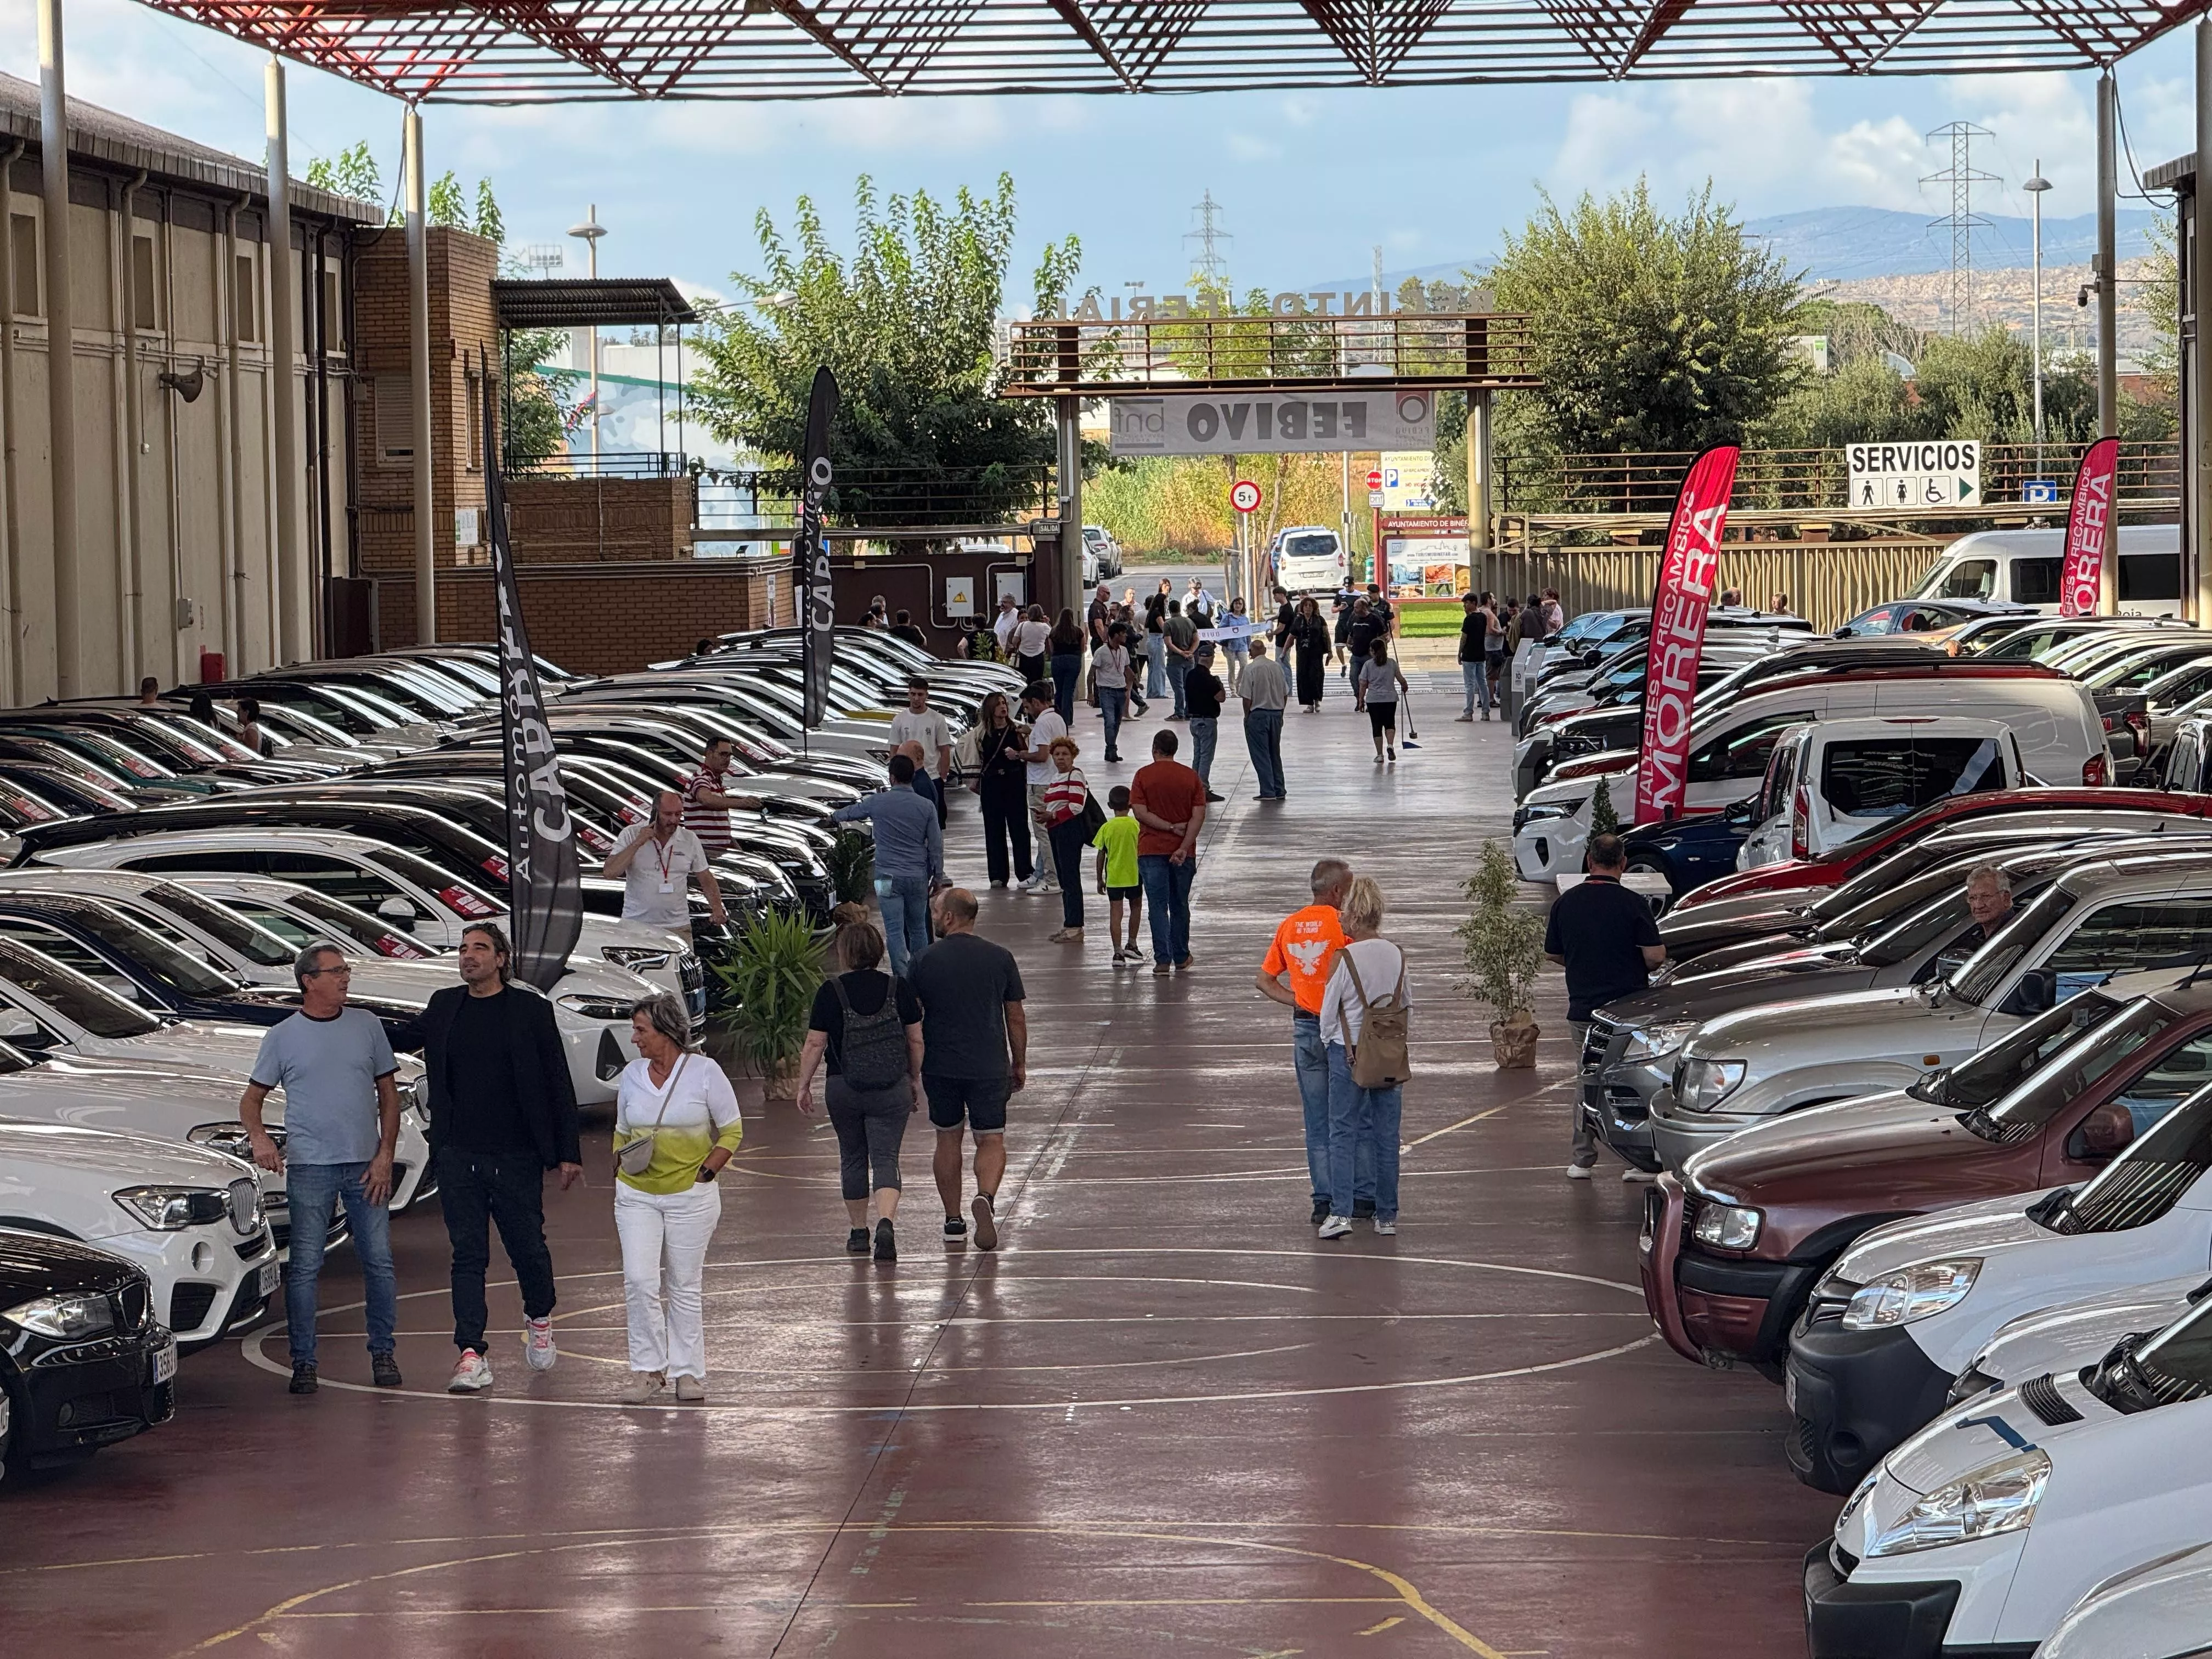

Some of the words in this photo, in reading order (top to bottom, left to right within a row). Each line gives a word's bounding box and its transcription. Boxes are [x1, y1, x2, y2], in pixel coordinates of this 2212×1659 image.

[1238, 492, 1246, 502] 5
[1852, 444, 1975, 473] SERVICIOS
[1656, 491, 1695, 647] RECAMBIOS
[2063, 575, 2075, 615] ERES
[2072, 466, 2091, 557] RECAMBIOS
[2073, 472, 2111, 614] ORERA
[1652, 504, 1727, 810] MORERA
[1653, 653, 1663, 670] Y
